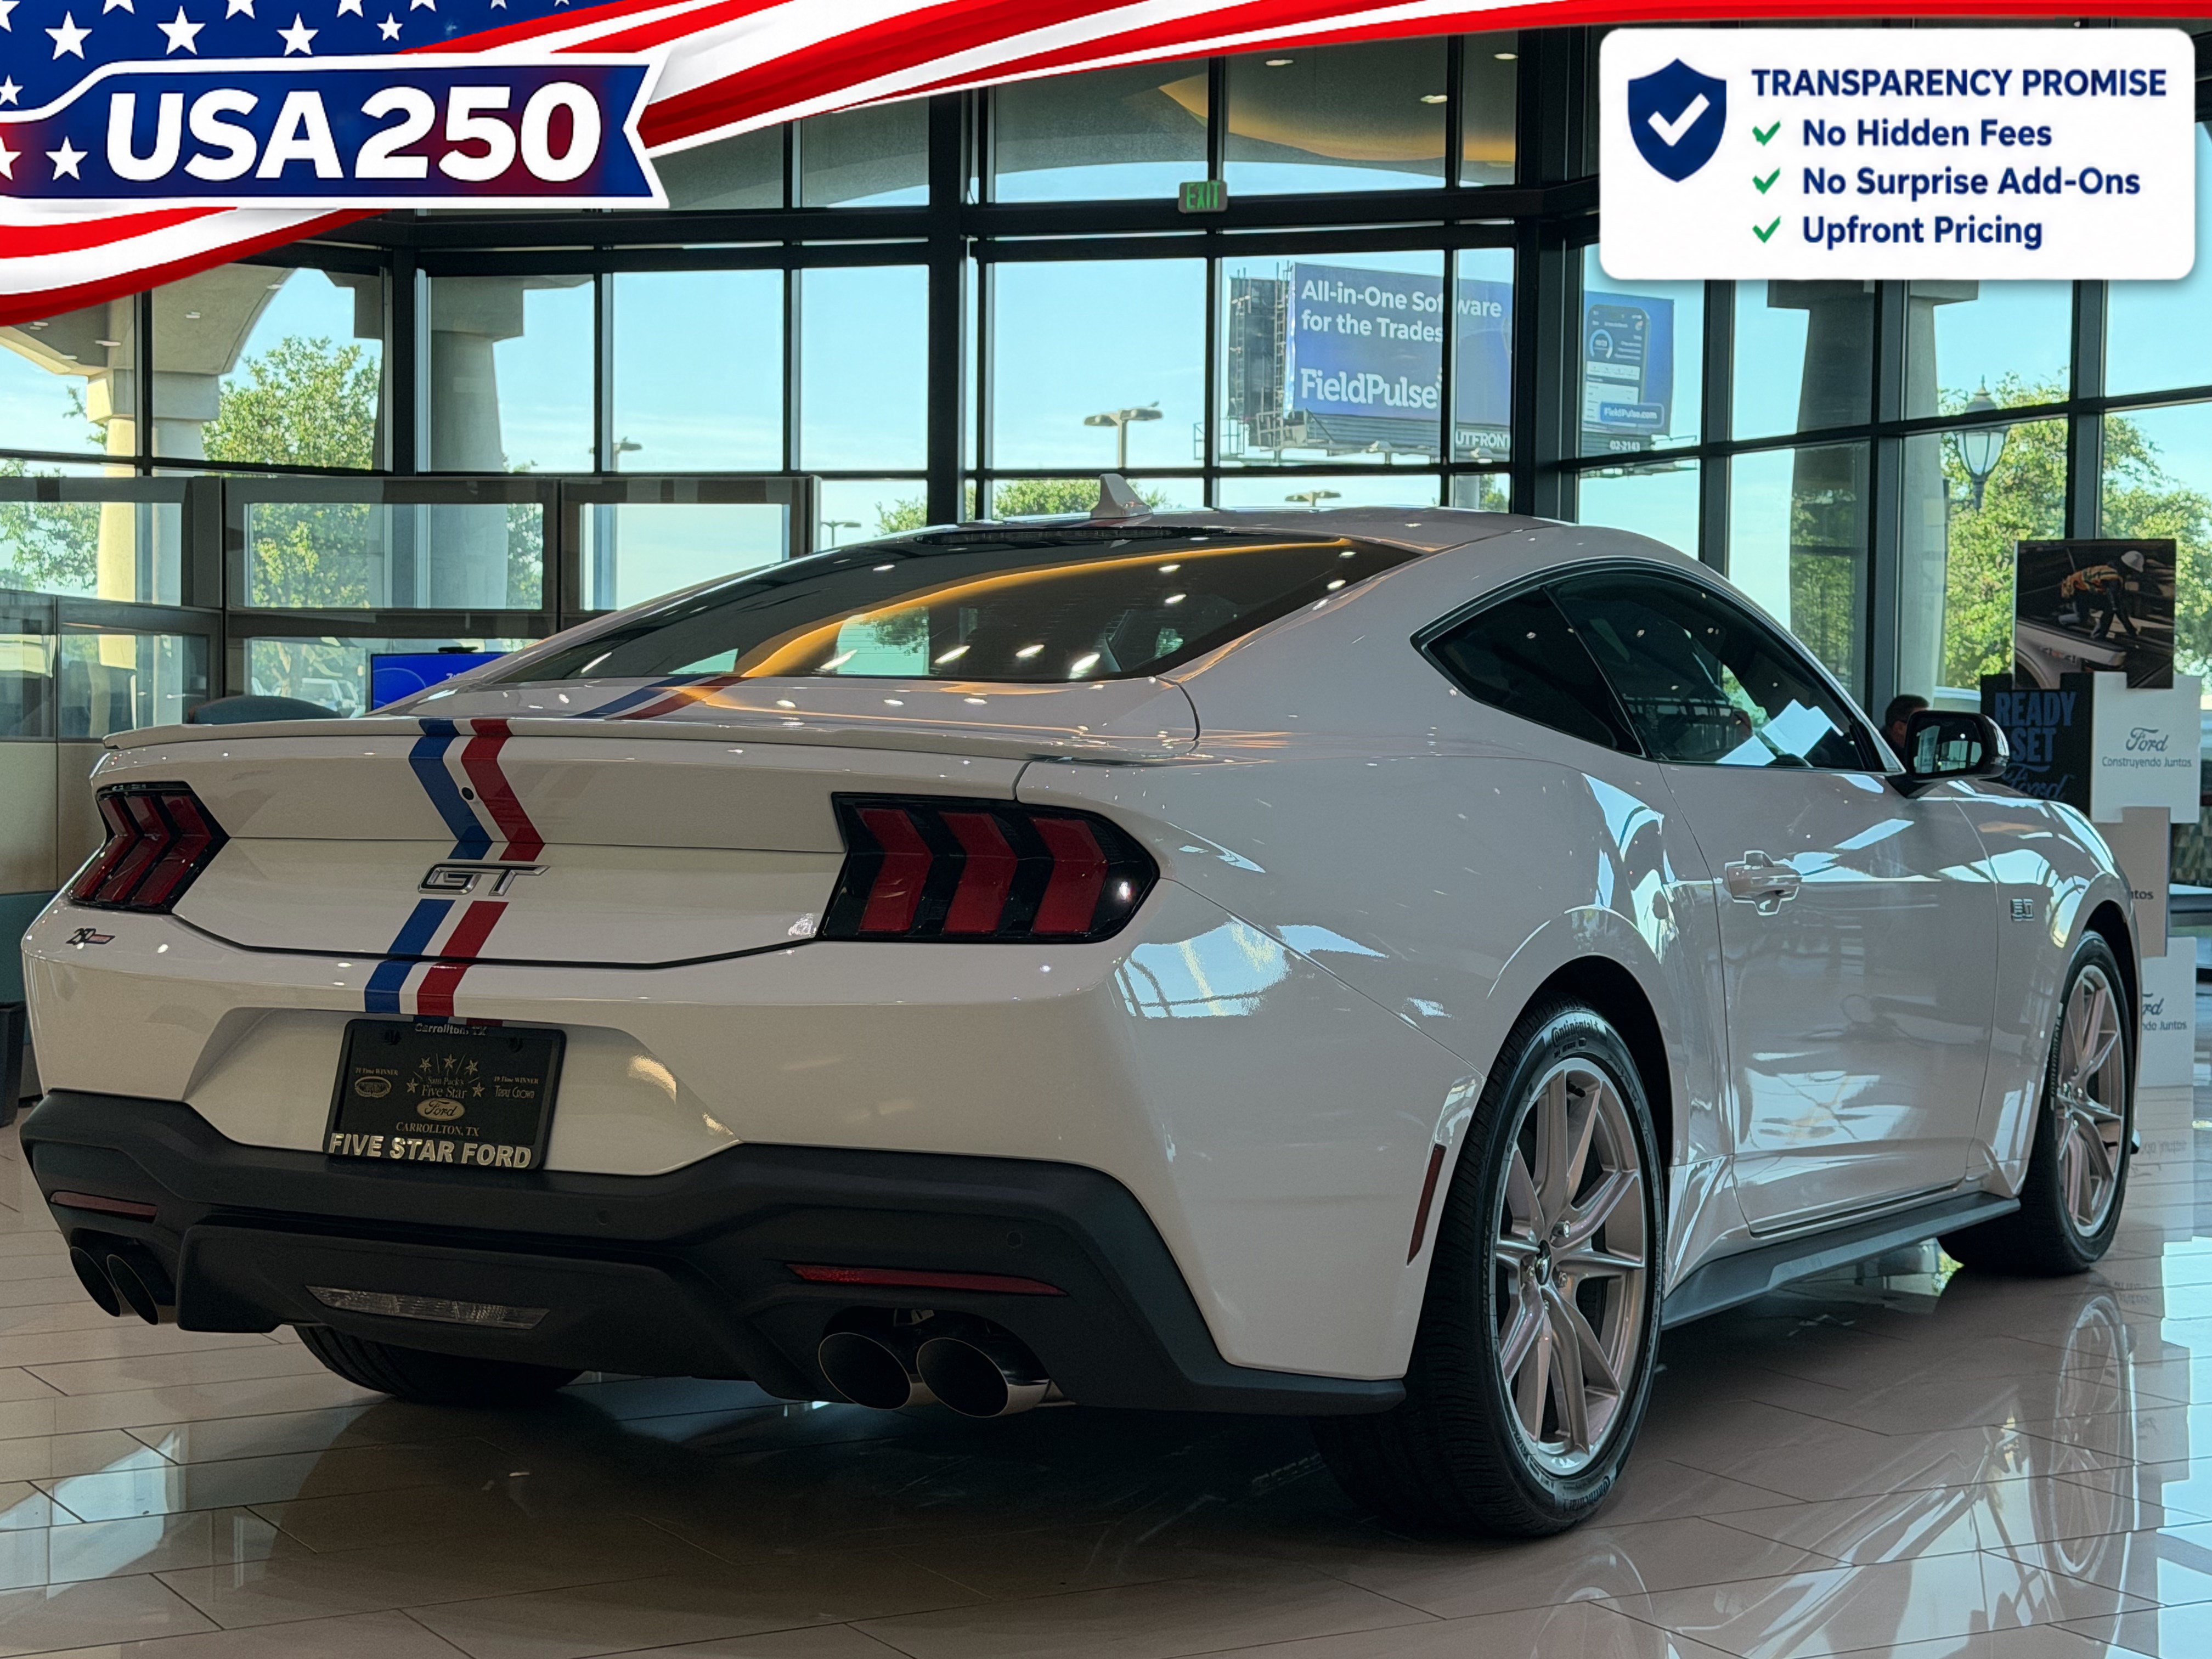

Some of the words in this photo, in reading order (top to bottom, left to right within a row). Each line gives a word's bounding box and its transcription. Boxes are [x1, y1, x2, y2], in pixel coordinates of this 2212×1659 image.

[1186, 183, 1220, 210] EXIT
[1301, 279, 1408, 310] All-in-One
[1412, 291, 1502, 318] Sofware
[1301, 309, 1332, 332] for
[1336, 312, 1372, 336] the
[1376, 317, 1443, 343] Trades
[1300, 368, 1438, 409] FieldPulse
[1995, 691, 2077, 727] READY
[2011, 726, 2057, 763] SET
[2125, 727, 2169, 752] Ford
[2102, 756, 2162, 769] Construyendo
[2164, 757, 2192, 768] Juntos
[417, 861, 551, 897] GT
[2159, 1020, 2188, 1031] Juntos
[421, 1084, 444, 1098] Five
[445, 1086, 468, 1099] Star
[424, 1099, 458, 1118] Ford
[465, 1126, 480, 1137] TX
[329, 1132, 385, 1158] FIVE
[389, 1137, 455, 1164] STAR
[460, 1142, 532, 1169] FORD
